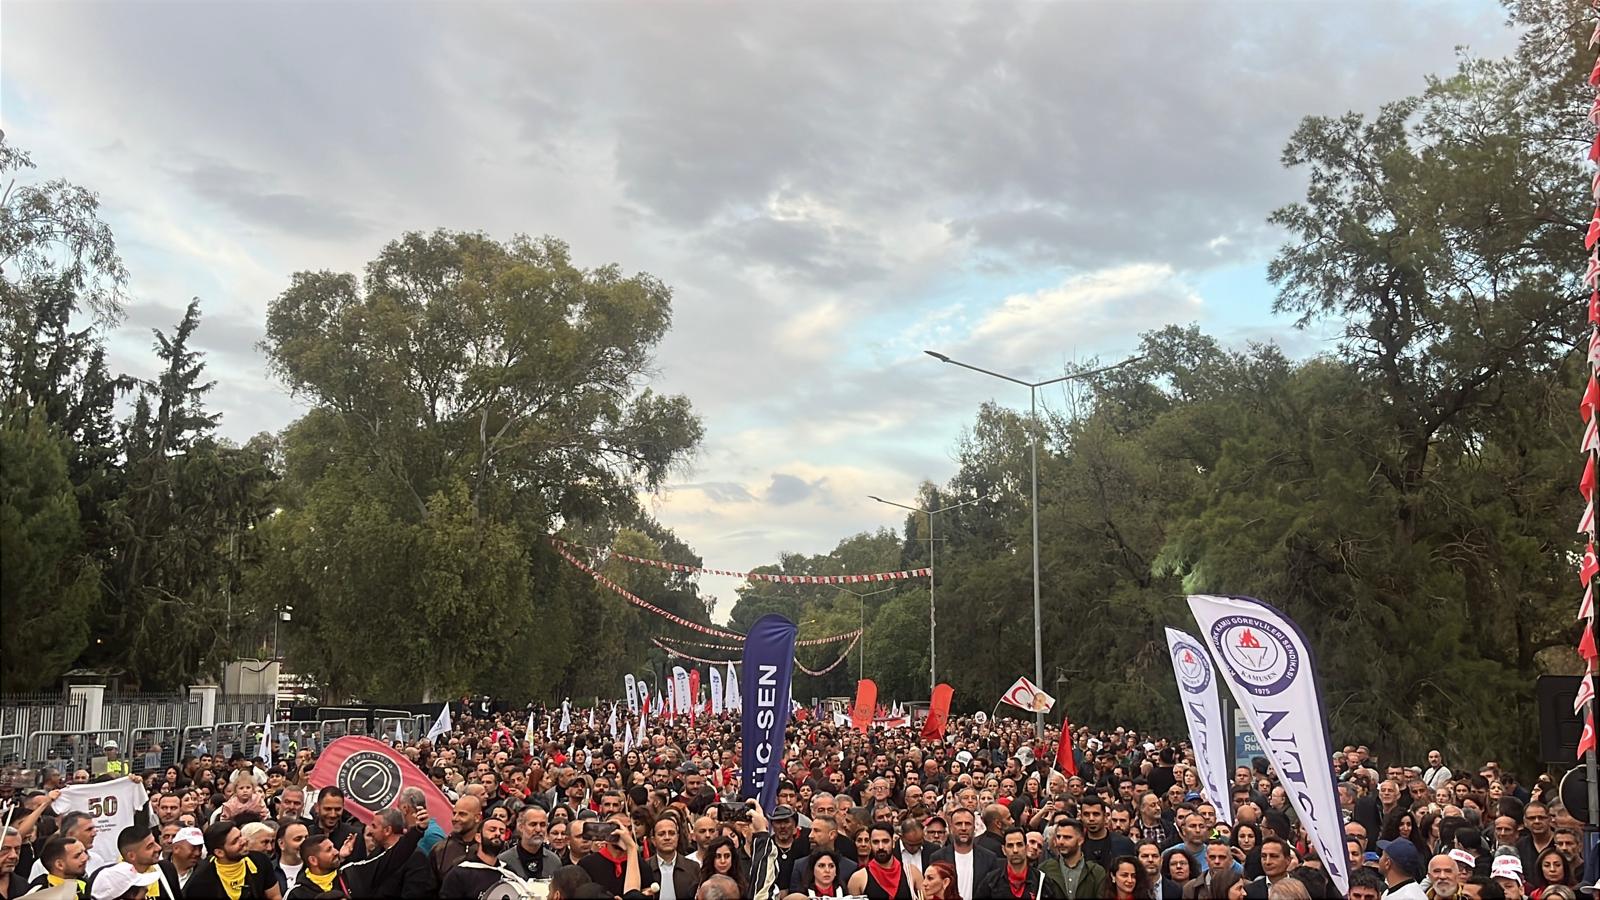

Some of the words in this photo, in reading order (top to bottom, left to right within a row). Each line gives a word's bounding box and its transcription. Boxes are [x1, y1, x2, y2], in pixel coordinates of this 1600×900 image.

[1241, 671, 1278, 682] KAMUSEN
[1243, 734, 1257, 743] Gü
[1244, 743, 1262, 752] Rek
[88, 795, 117, 817] 50
